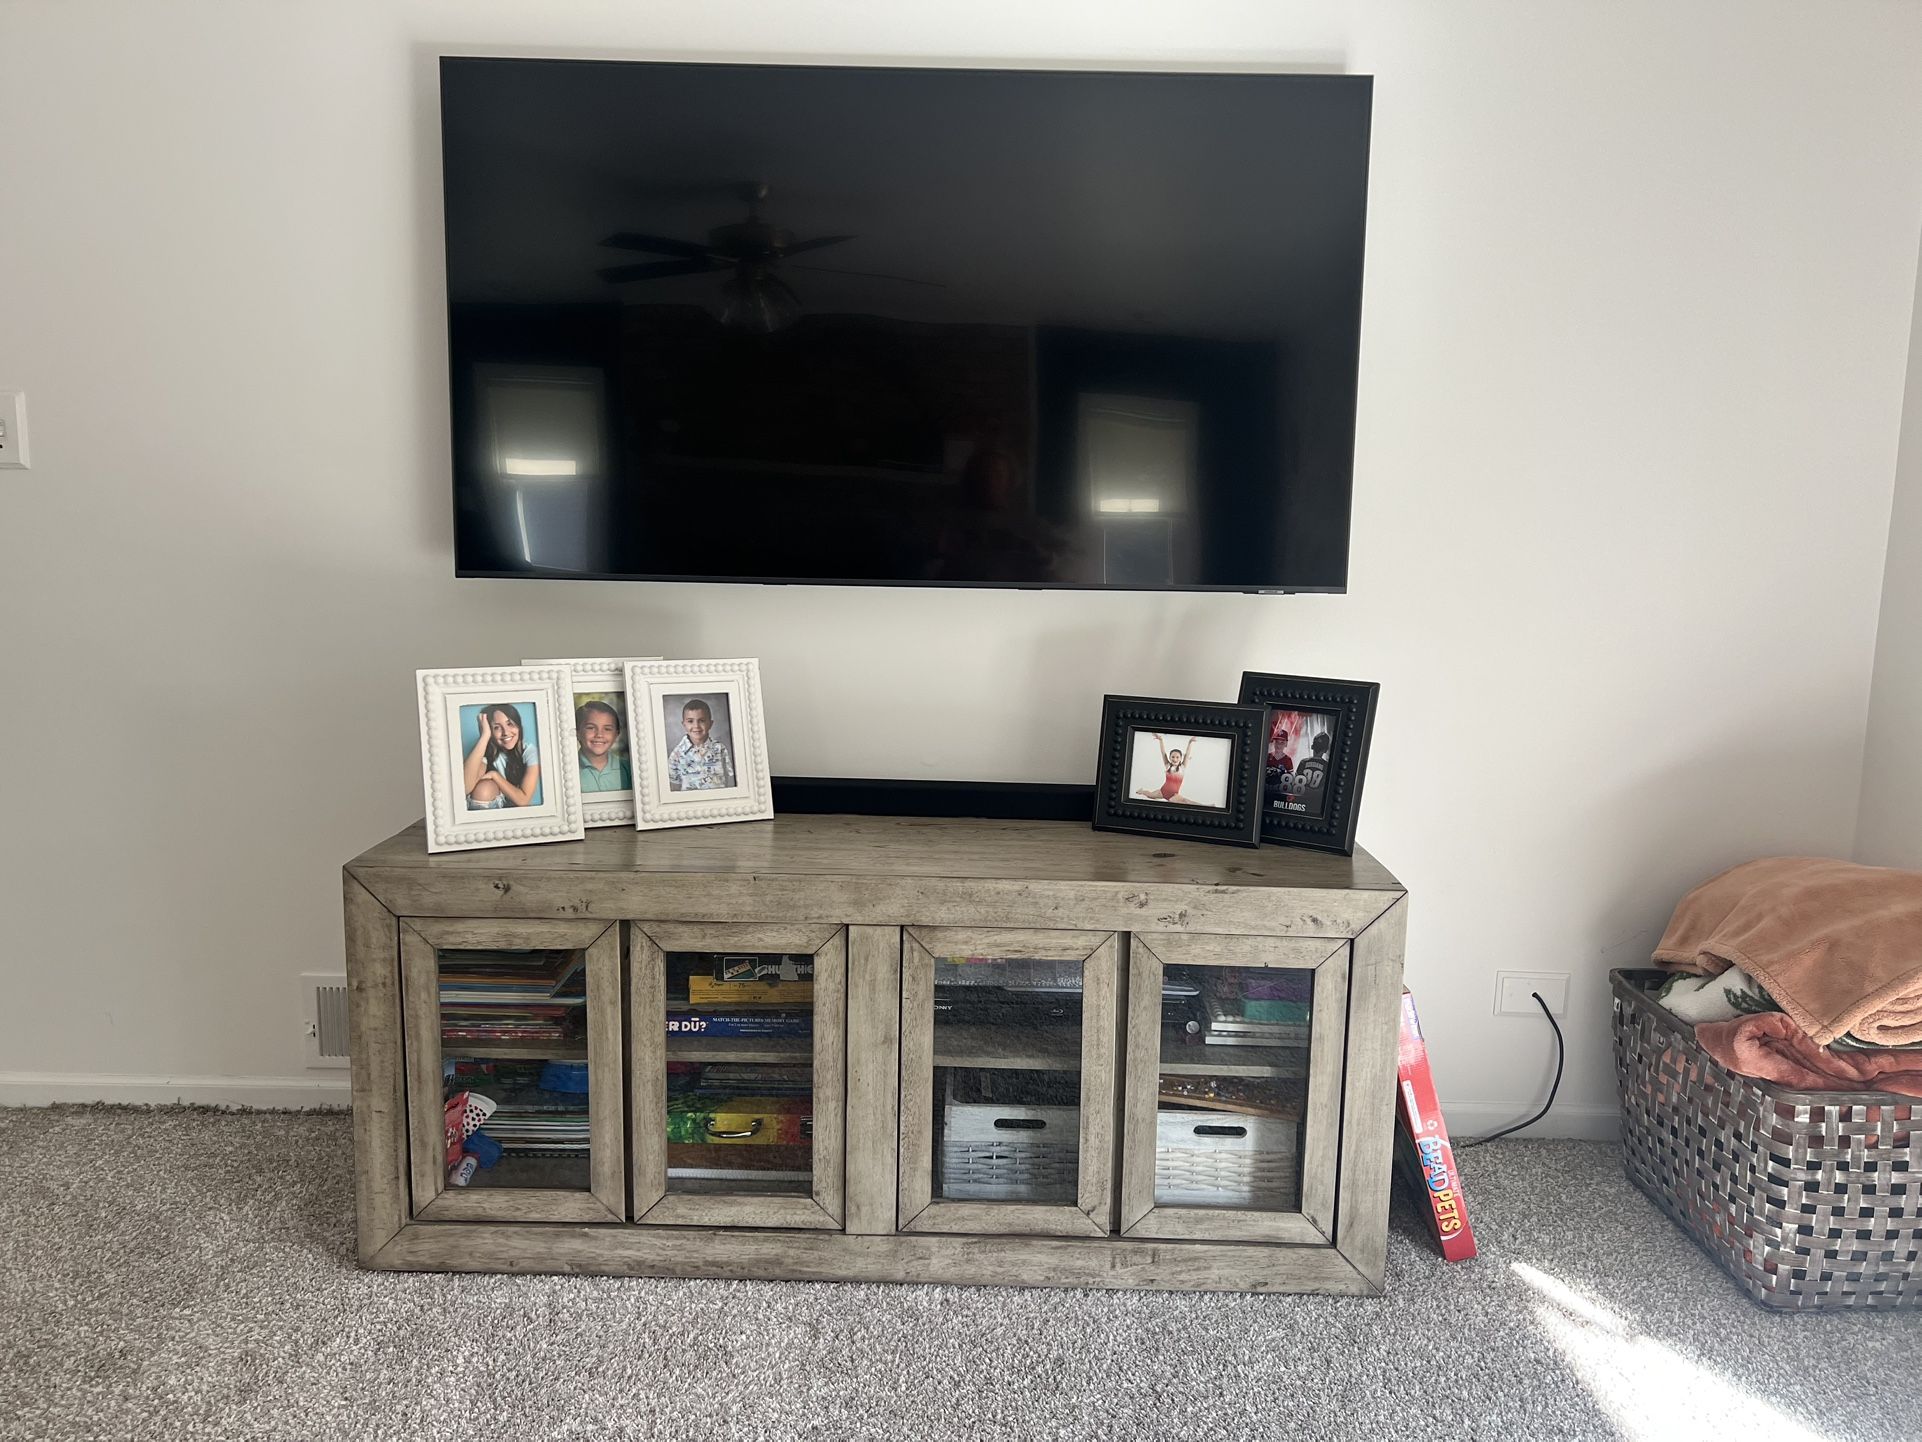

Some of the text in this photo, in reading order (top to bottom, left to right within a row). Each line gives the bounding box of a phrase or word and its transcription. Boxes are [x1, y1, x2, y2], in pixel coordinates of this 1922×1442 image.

[1280, 773, 1307, 795] 88
[1273, 800, 1306, 812] BULLDOGS
[1418, 1137, 1462, 1233] BEAD PETS
